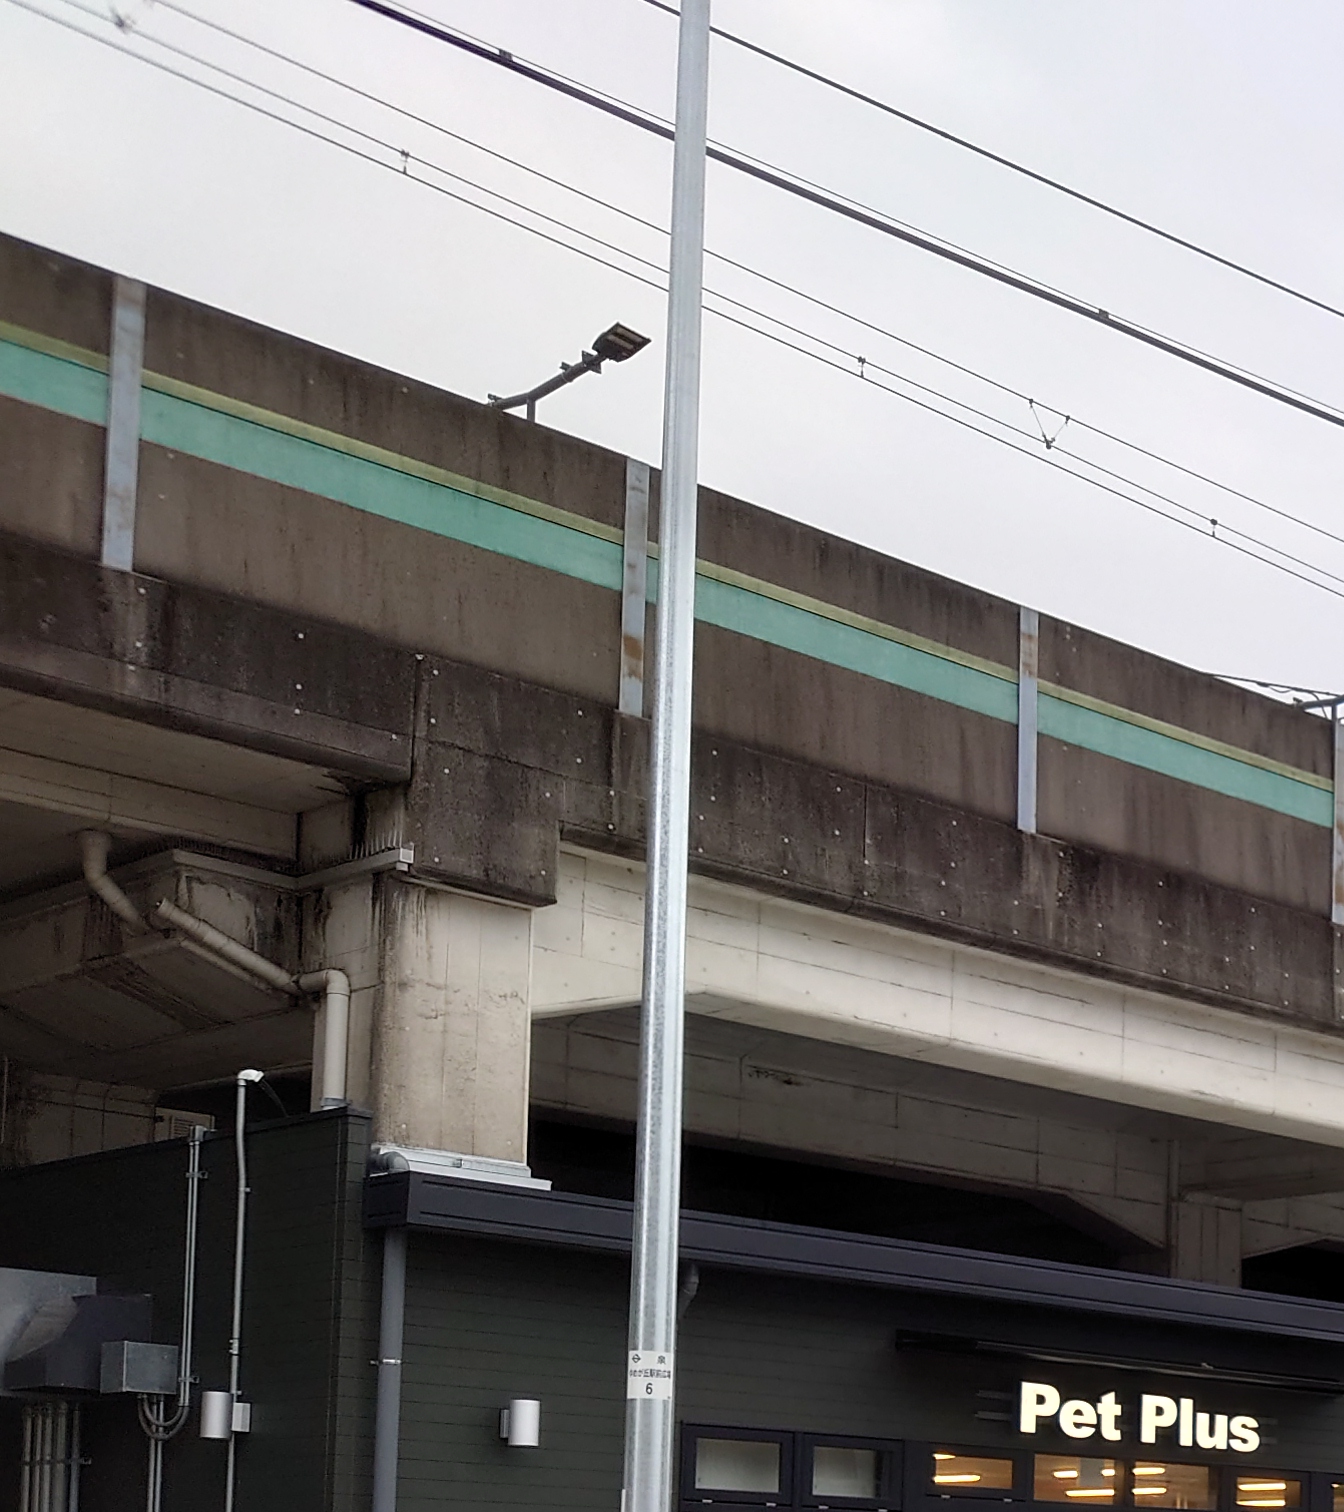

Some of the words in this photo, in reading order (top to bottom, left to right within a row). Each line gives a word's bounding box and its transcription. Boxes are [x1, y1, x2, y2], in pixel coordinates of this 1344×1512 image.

[645, 1382, 653, 1395] 6
[1020, 1381, 1122, 1441] Pet
[1140, 1393, 1260, 1452] Plus
